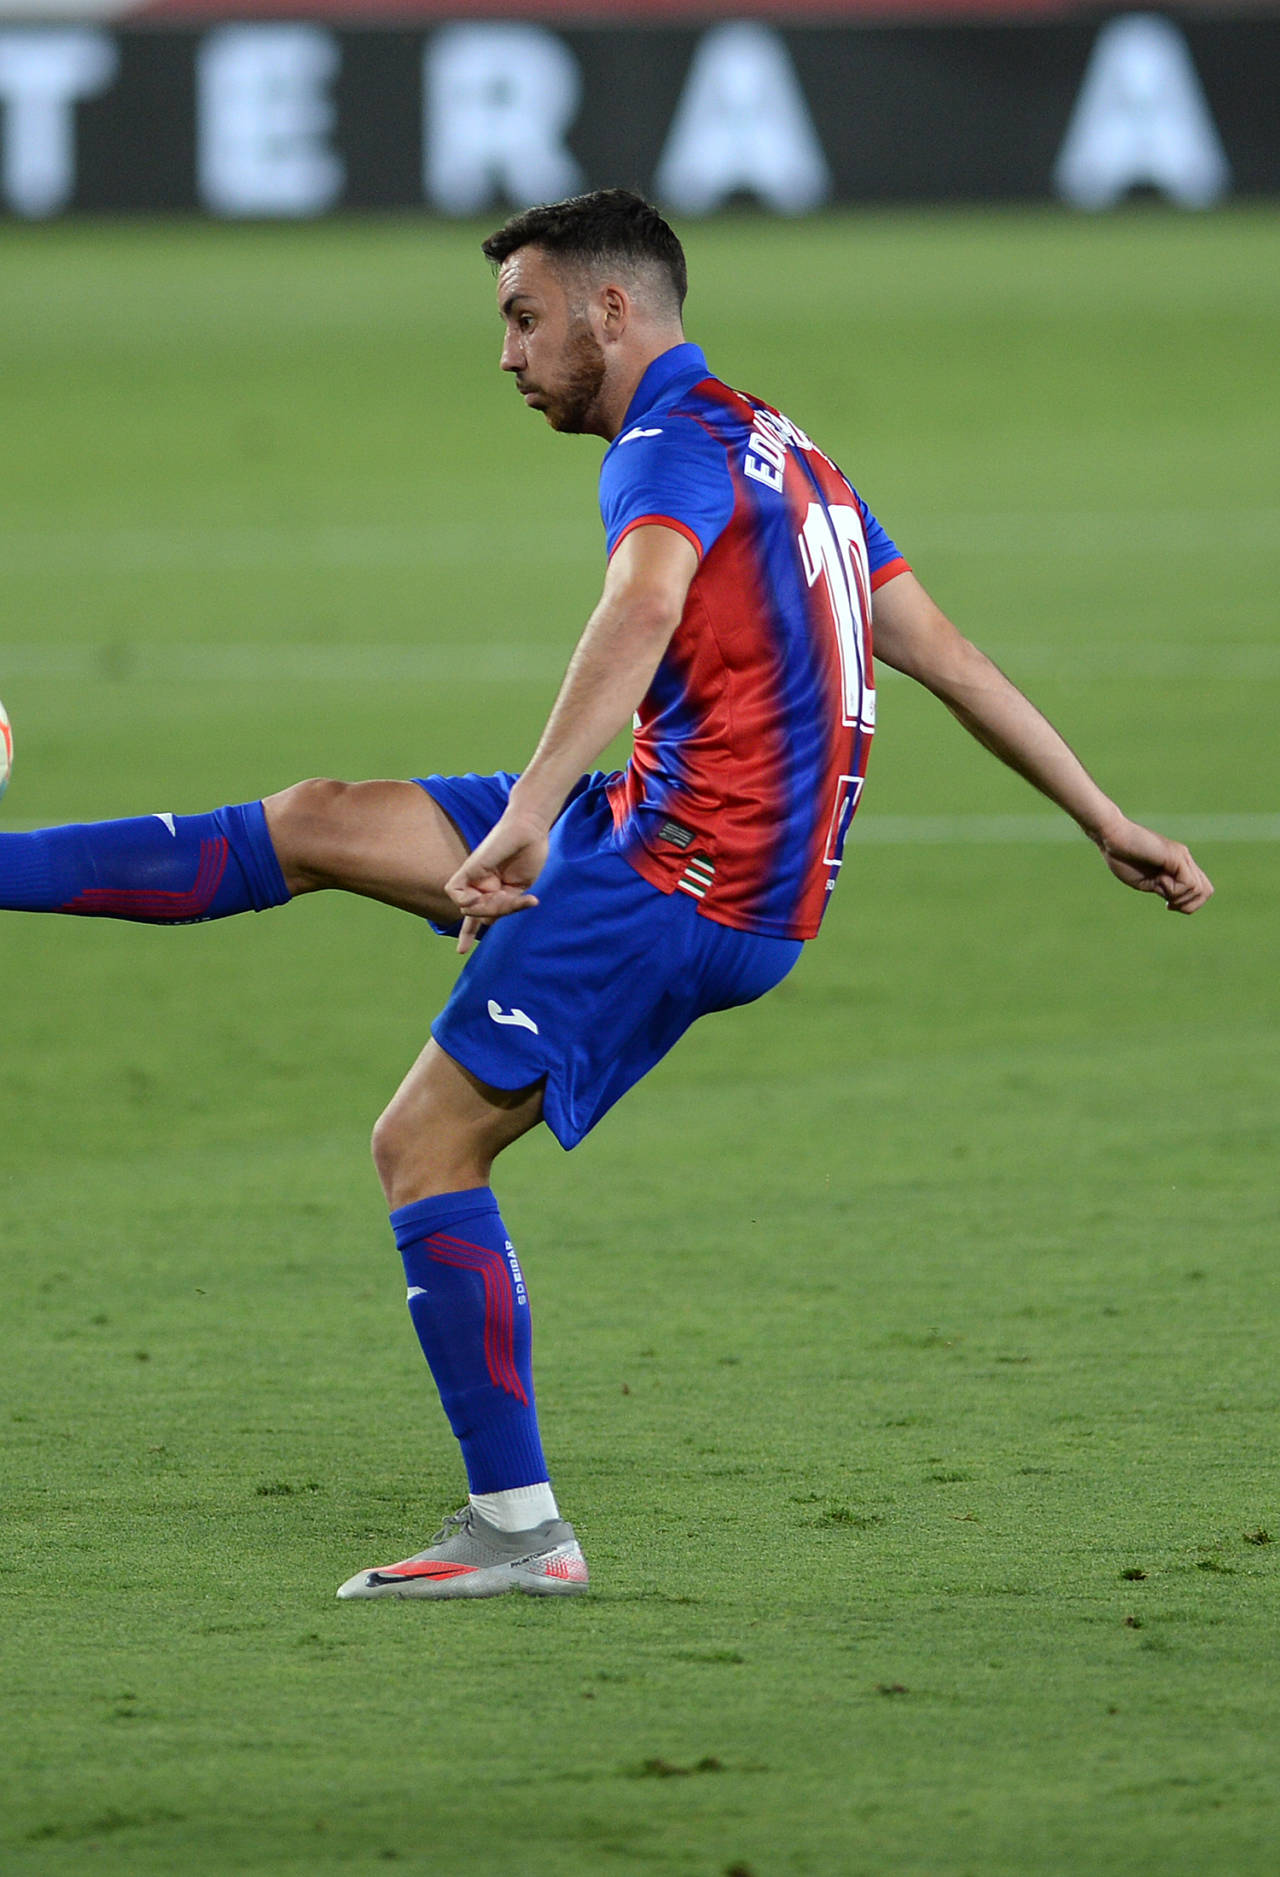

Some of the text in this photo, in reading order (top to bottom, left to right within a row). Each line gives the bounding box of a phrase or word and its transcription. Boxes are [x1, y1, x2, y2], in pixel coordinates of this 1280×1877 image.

[1054, 11, 1231, 212] A
[798, 501, 876, 735] 10
[505, 1240, 522, 1282] EIBAR
